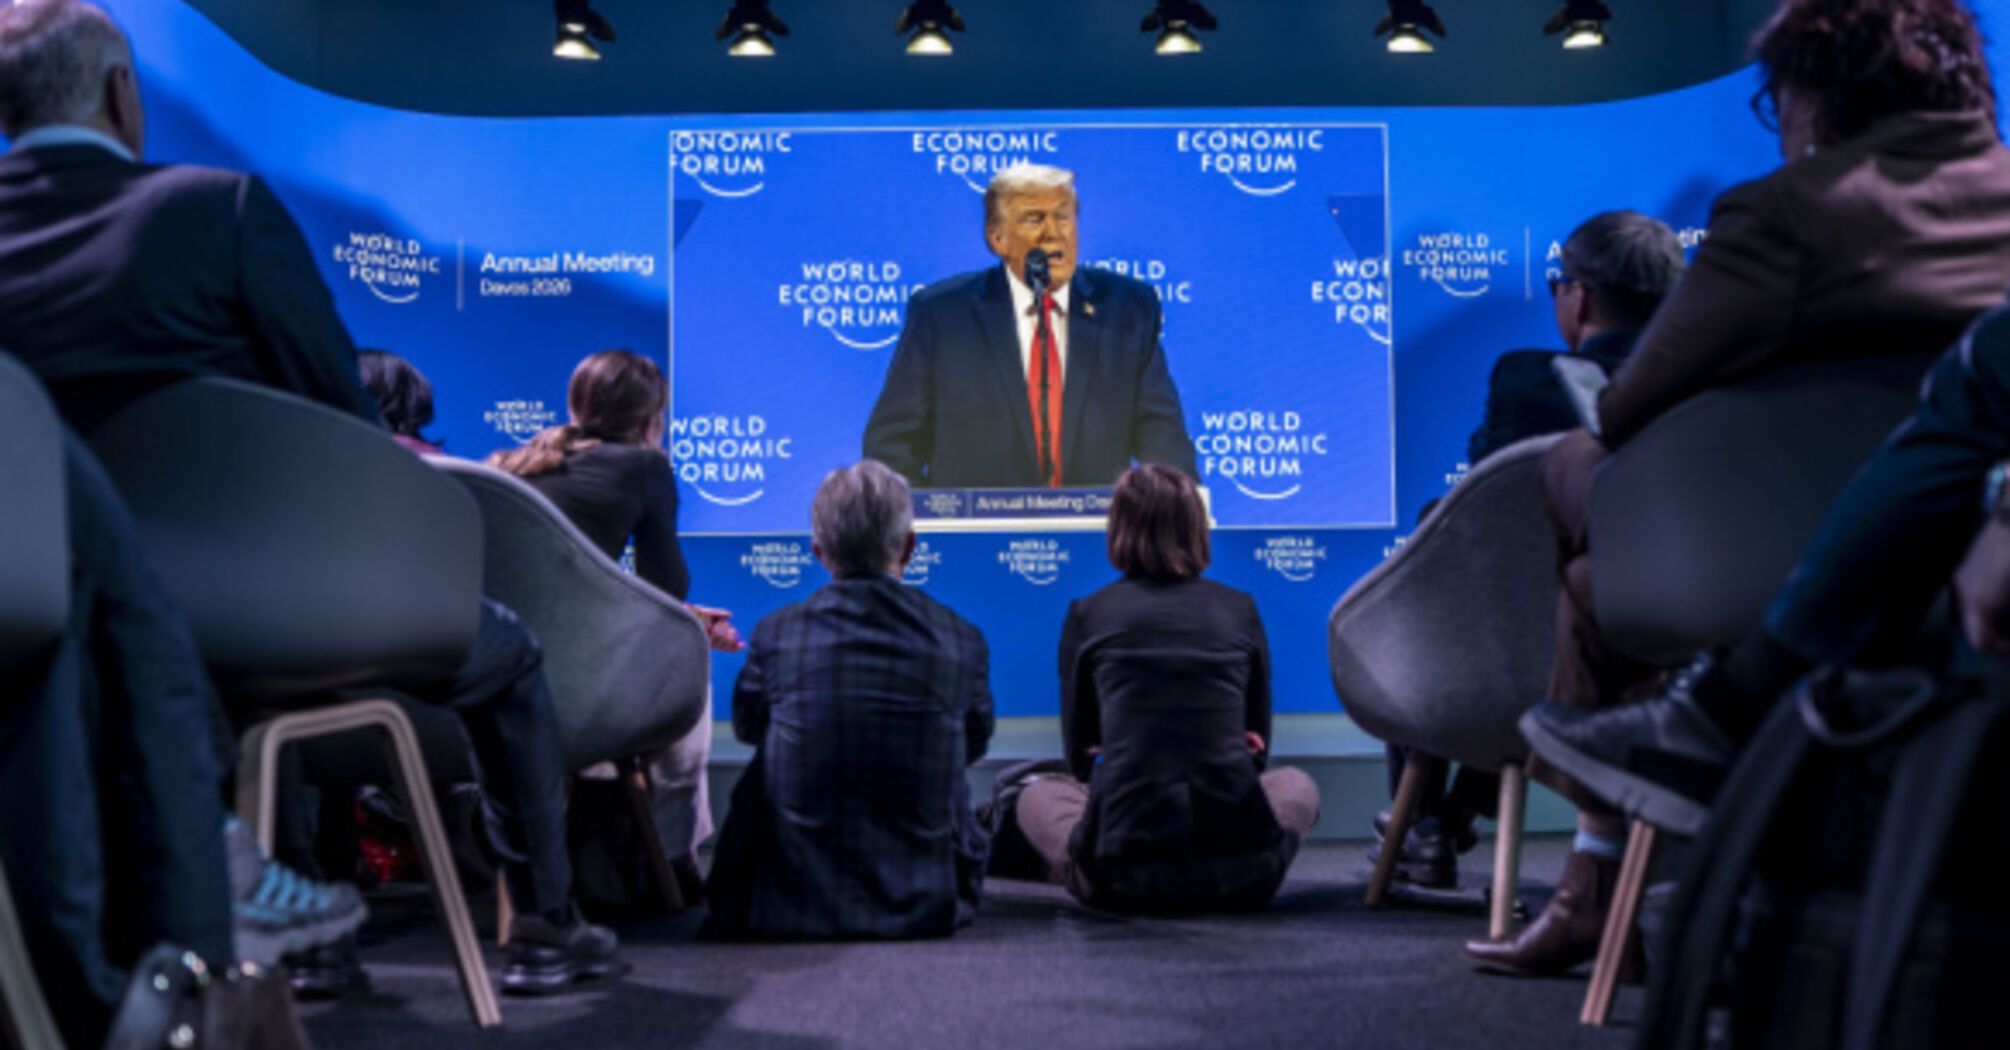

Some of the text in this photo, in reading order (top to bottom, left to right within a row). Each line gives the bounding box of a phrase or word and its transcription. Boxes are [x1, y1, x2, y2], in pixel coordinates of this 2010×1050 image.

[676, 132, 791, 152] ONOMIC
[913, 132, 1059, 152] ECONOMIC
[1177, 130, 1323, 151] ECONOMIC
[1201, 153, 1297, 173] FORUM
[350, 232, 420, 255] WORLD
[1418, 232, 1489, 249] WORLD
[334, 245, 440, 273] ECONOMIC
[480, 252, 654, 276] Annual Meeting
[1403, 250, 1508, 266] ECONOMIC
[349, 264, 420, 287] FORUM
[802, 261, 901, 282] WORLD
[1420, 266, 1490, 281] FORUM
[480, 278, 529, 296] Davos
[1311, 281, 1386, 302] ECON
[803, 306, 899, 327] FORUM
[1335, 304, 1388, 324] FOR
[1202, 411, 1300, 431] WORLD
[674, 438, 792, 459] ONOMIC
[1195, 434, 1327, 454] CONOMIC
[672, 462, 765, 482] ORUM
[1205, 456, 1301, 477] FORUM
